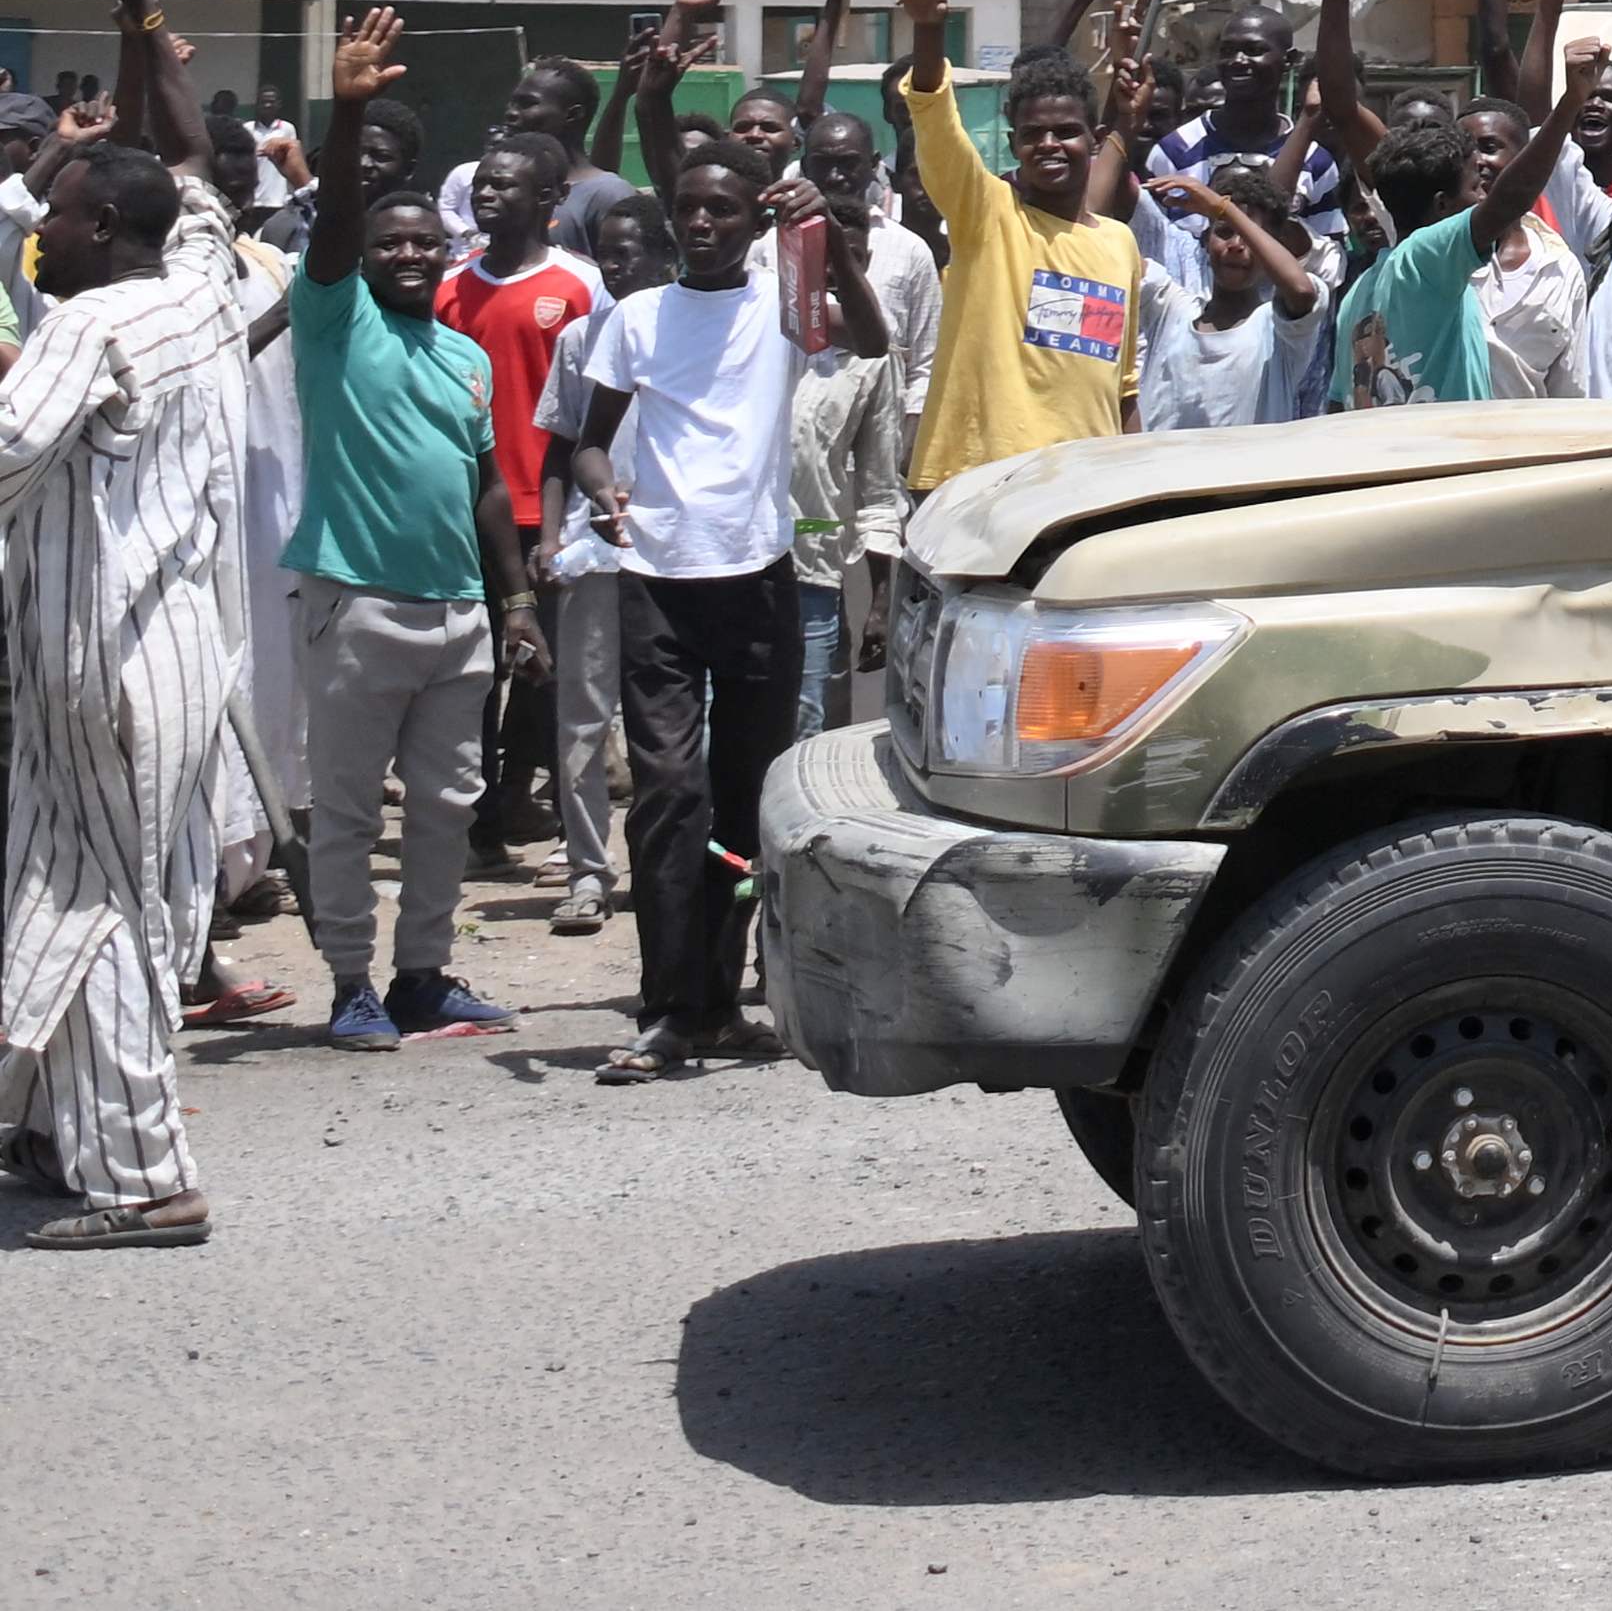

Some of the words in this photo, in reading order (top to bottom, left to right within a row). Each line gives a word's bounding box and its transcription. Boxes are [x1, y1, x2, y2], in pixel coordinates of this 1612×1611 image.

[785, 259, 800, 335] PINE
[1039, 272, 1123, 302] TOMMY
[810, 289, 821, 329] PINE
[1028, 330, 1115, 359] JEANS
[1242, 989, 1333, 1260] DUNLOP
